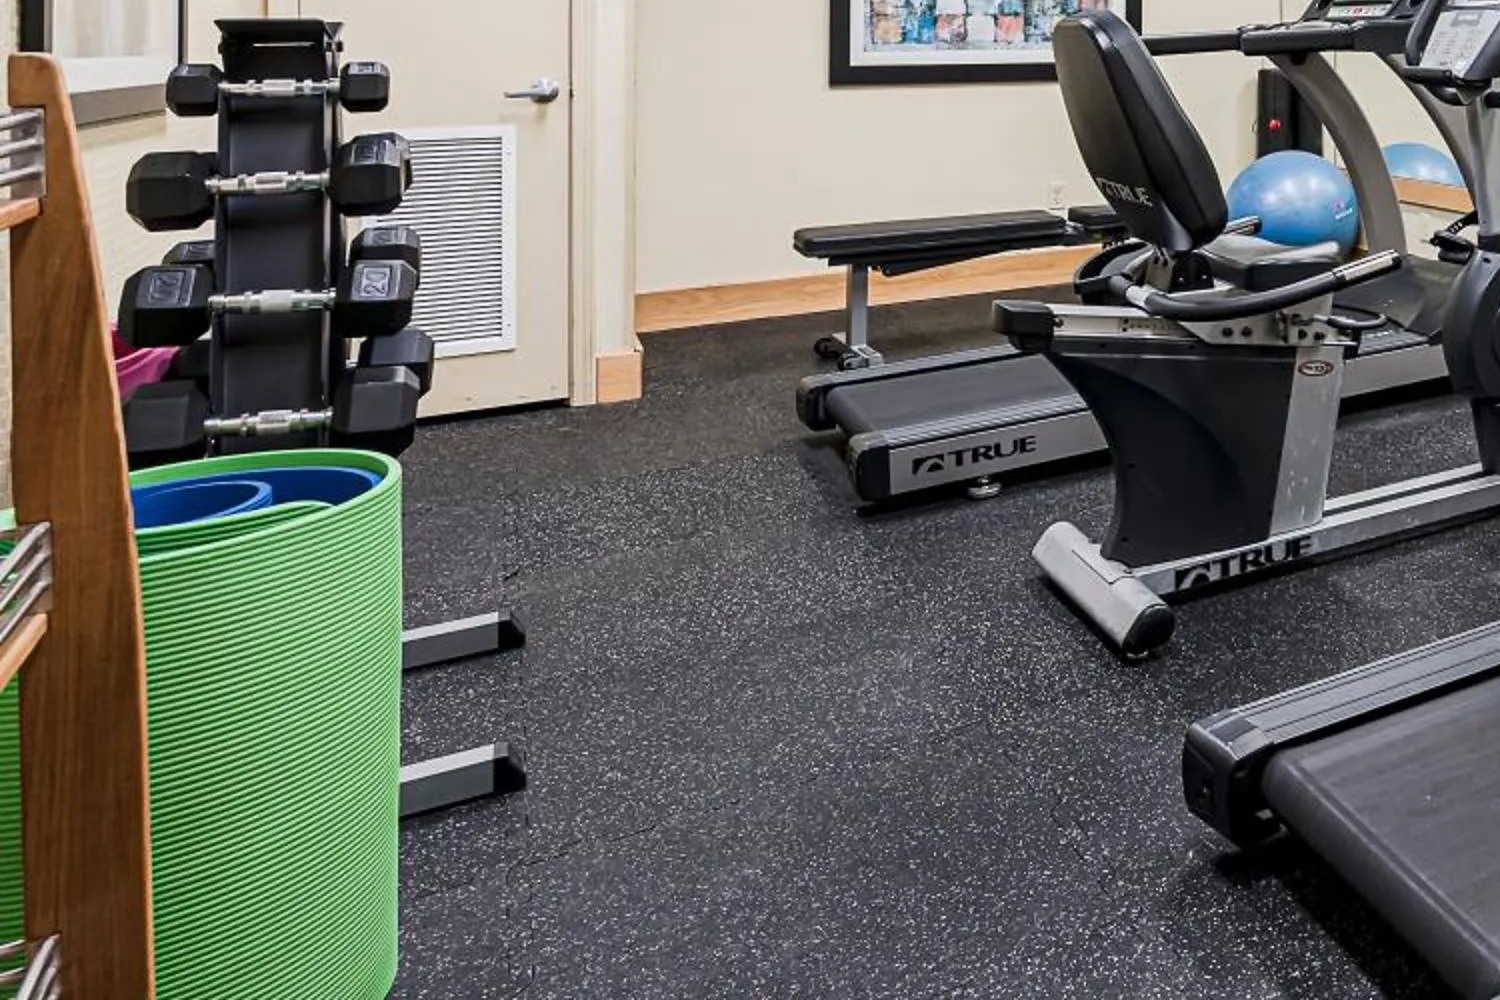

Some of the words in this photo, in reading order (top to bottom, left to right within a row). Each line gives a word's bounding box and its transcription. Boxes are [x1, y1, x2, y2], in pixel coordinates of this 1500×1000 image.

[364, 270, 388, 296] 20
[947, 435, 1037, 467] TRUE
[1210, 535, 1312, 578] TRUE
